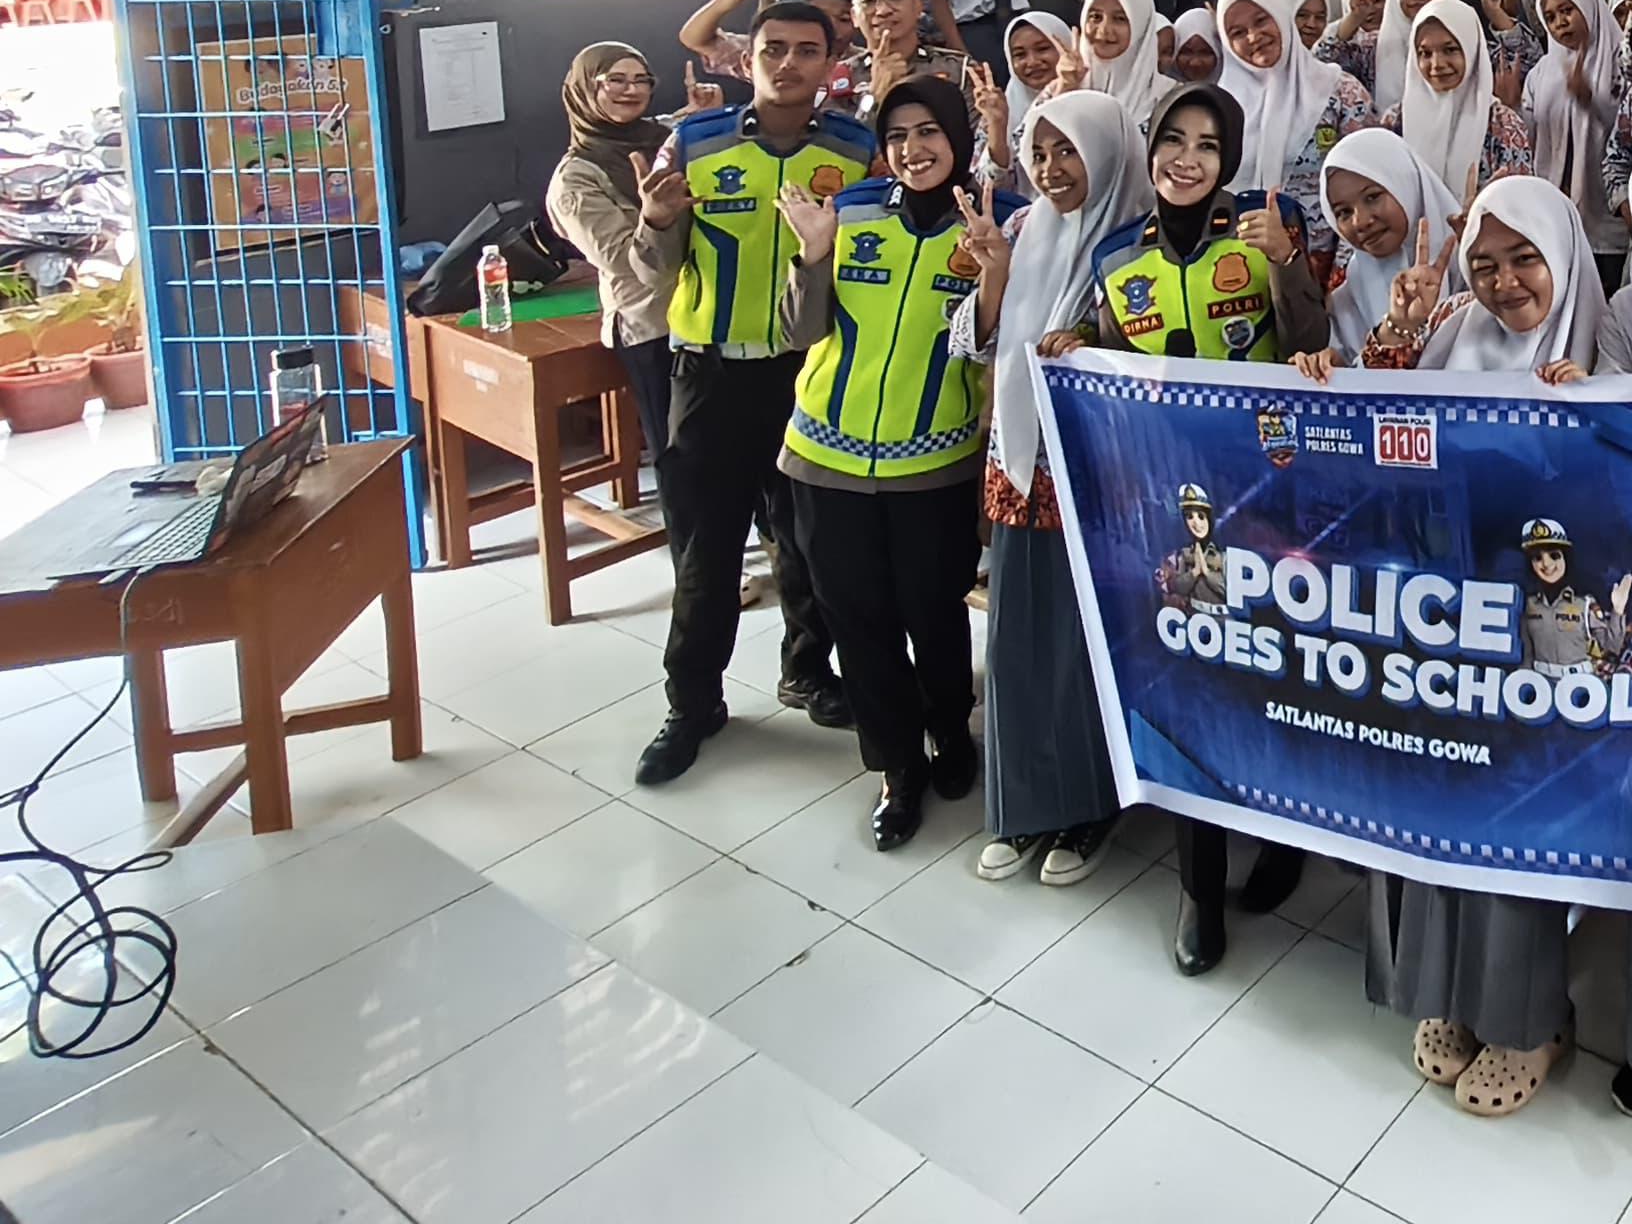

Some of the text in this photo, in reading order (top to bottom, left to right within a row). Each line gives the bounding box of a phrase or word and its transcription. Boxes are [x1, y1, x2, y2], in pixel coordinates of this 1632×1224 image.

[1211, 297, 1260, 315] POLRI
[1304, 425, 1352, 441] SATLANTAS
[1305, 439, 1337, 454] POLRES
[1338, 442, 1364, 456] GOWA
[1382, 429, 1429, 458] 110
[1226, 546, 1515, 654] POLICE
[1156, 606, 1283, 672] GOES
[1295, 633, 1367, 691] TO
[1265, 701, 1492, 766] SATLANTAS POLRES GOWA
